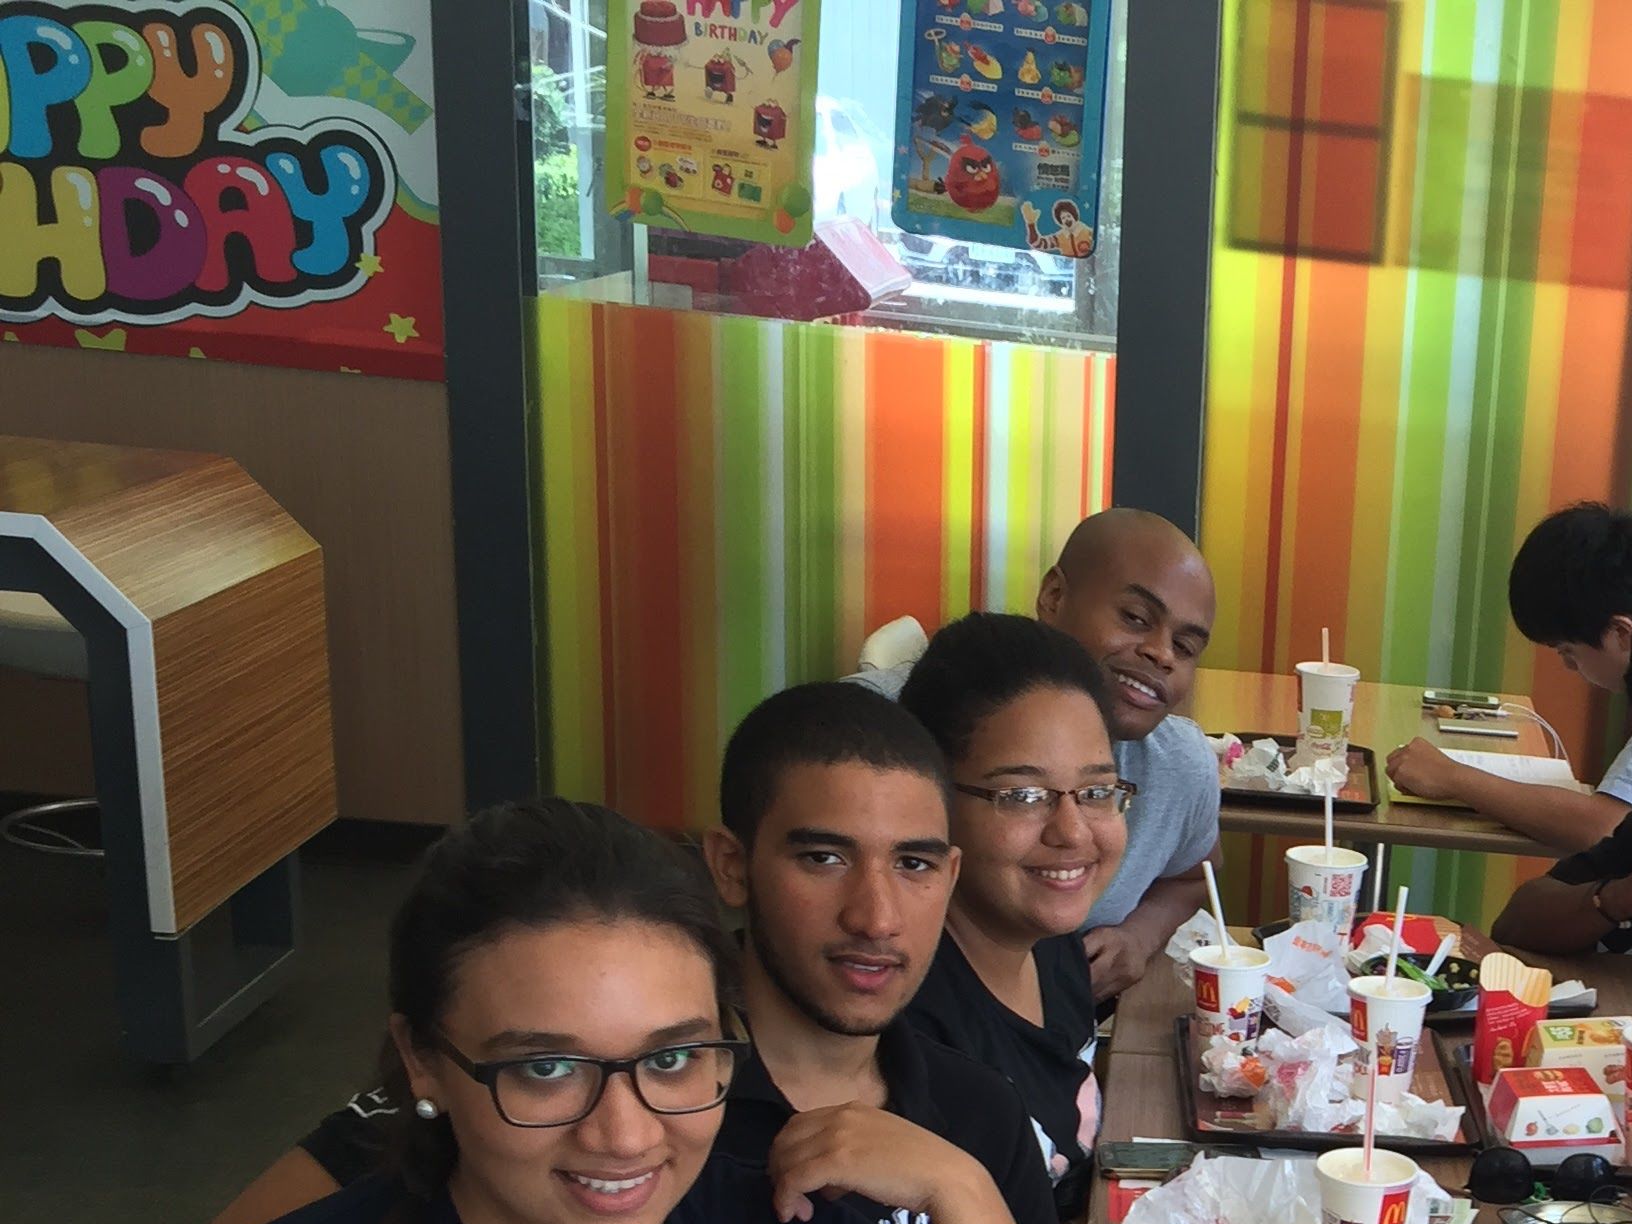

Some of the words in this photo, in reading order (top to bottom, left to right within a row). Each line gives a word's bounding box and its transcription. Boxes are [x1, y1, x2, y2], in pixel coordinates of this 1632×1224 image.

[0, 15, 235, 158] PPY
[694, 21, 769, 45] BIRTHDAY
[0, 145, 370, 300] HDAY
